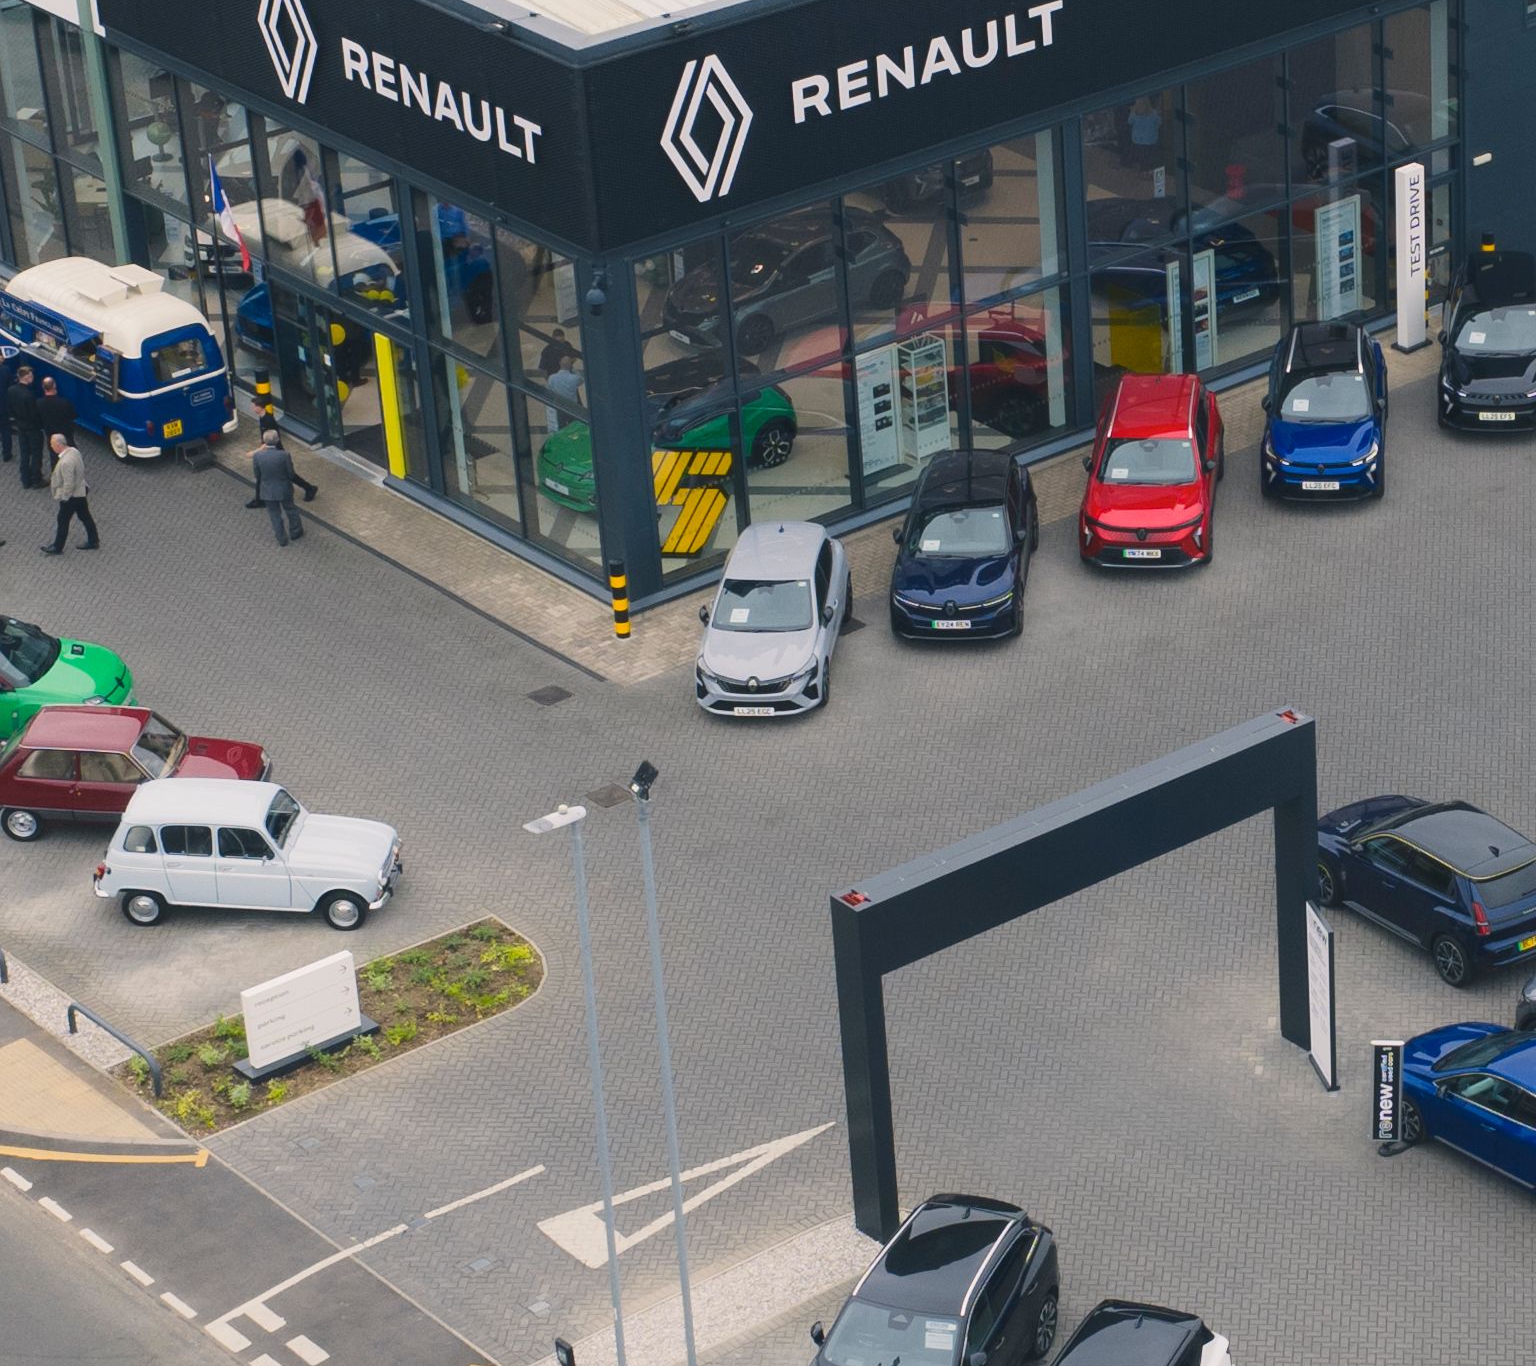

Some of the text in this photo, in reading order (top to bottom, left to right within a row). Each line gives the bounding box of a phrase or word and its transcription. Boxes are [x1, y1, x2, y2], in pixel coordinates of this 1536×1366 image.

[340, 36, 542, 164] RENAULT
[1409, 174, 1420, 277] TEST DRIVE
[254, 990, 289, 1007] reception
[257, 1013, 286, 1030] parking
[287, 1025, 315, 1042] parking
[1379, 1083, 1393, 1138] renew
